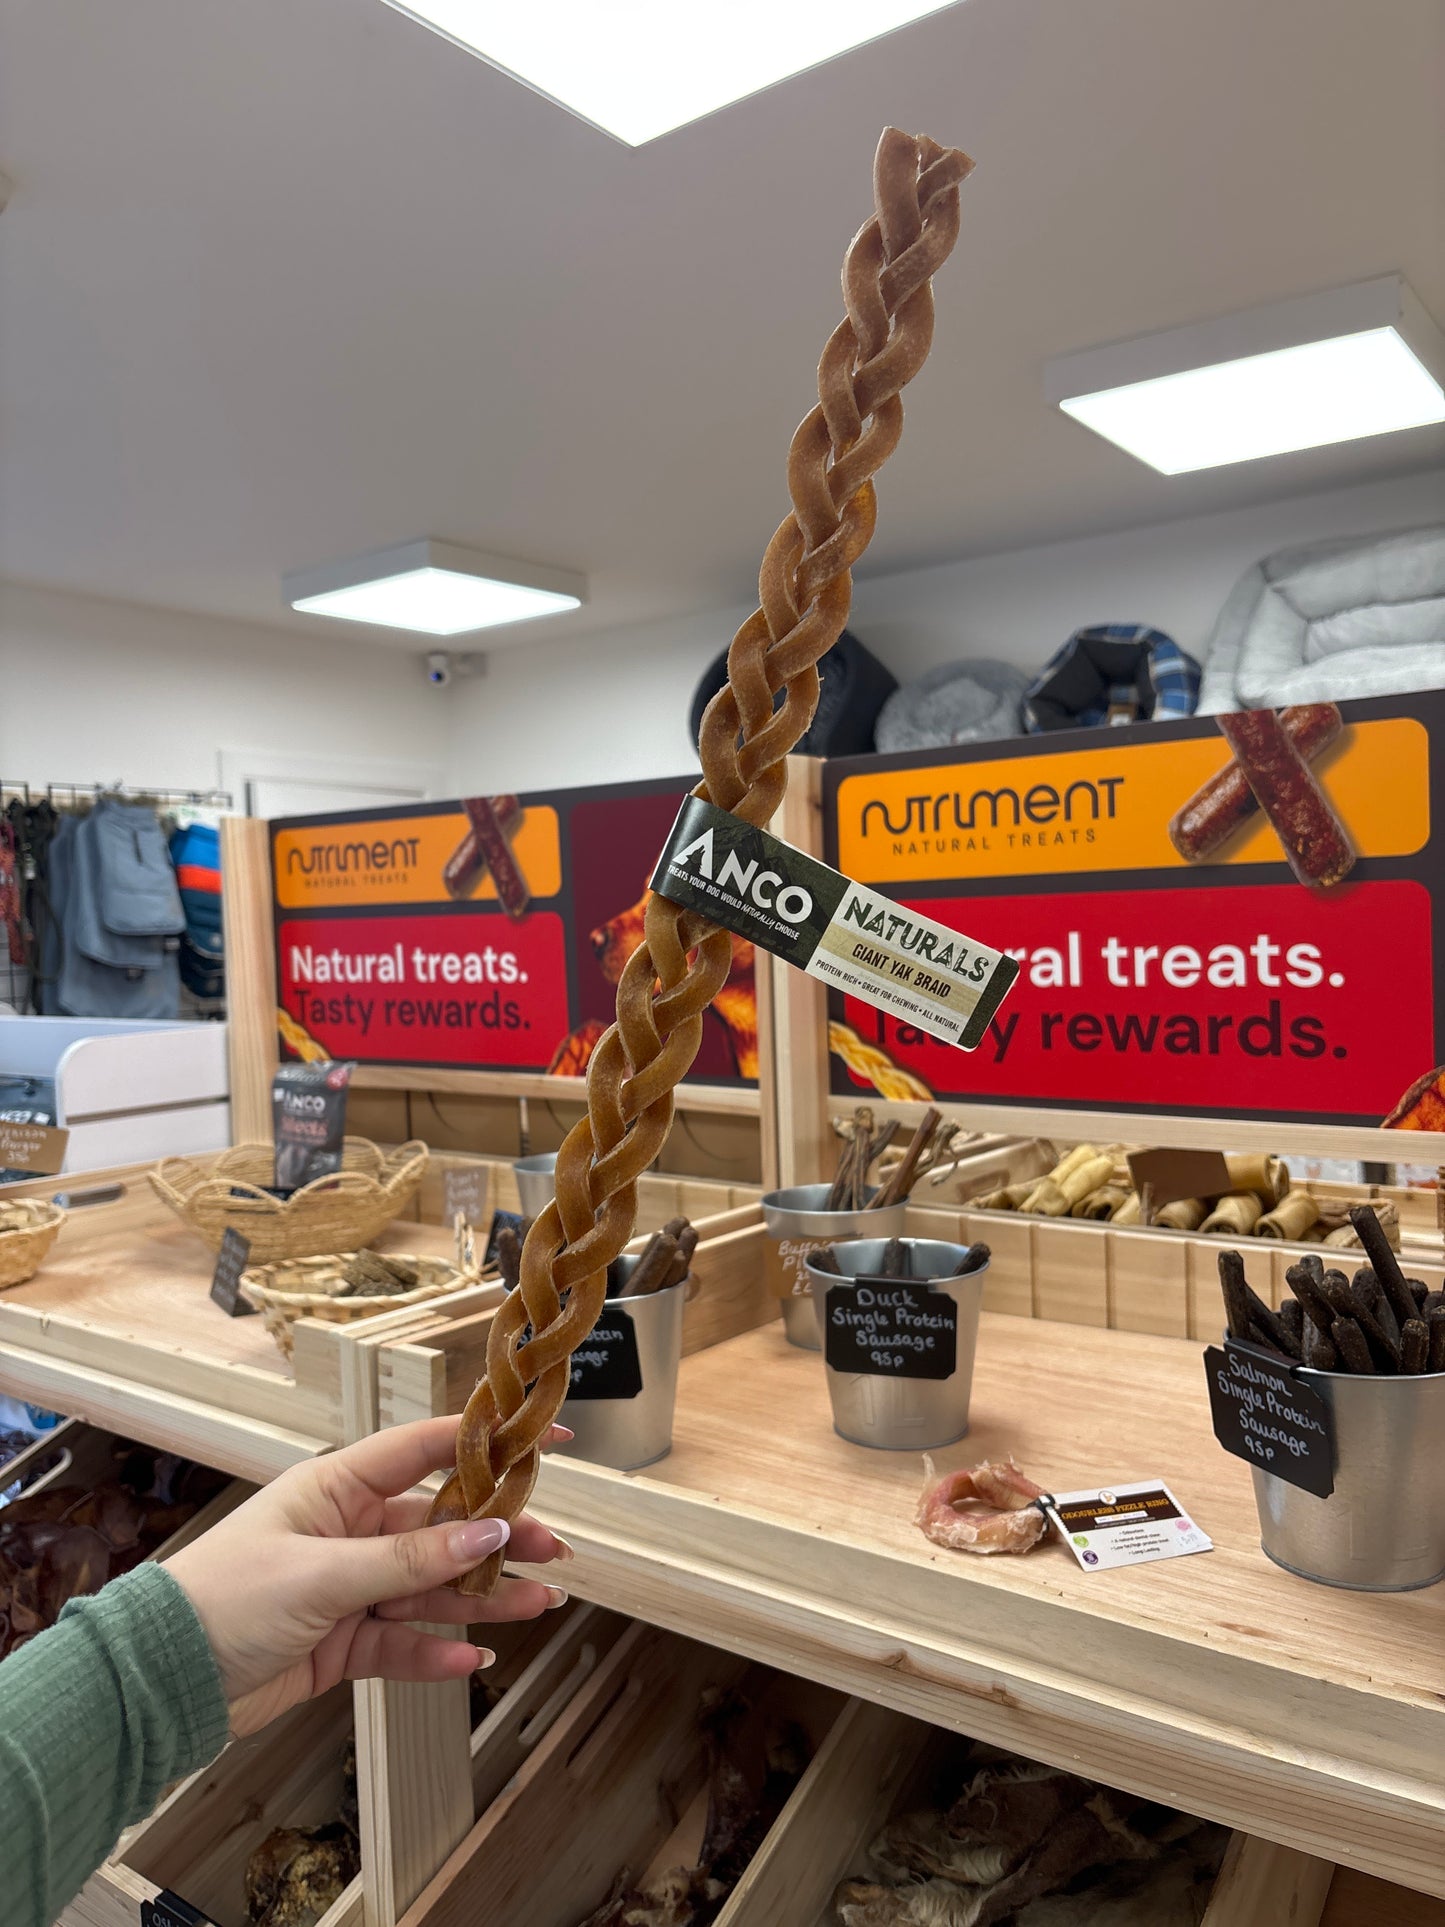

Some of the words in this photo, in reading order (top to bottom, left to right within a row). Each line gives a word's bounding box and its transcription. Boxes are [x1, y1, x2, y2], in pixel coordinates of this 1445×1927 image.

[892, 836, 991, 856] NATURAL
[1007, 828, 1097, 849] TREATS
[671, 827, 813, 924] ANCO
[667, 864, 689, 882] TREATS
[689, 874, 706, 892] YOUR
[706, 883, 721, 898] DOG
[720, 890, 743, 910] WOULD
[741, 903, 775, 930] NATURALLY
[774, 920, 801, 941] CHOOSE
[291, 942, 405, 983] Natural
[412, 946, 529, 984] treats.
[843, 896, 990, 983] NATURALS
[1101, 933, 1345, 988] treats.
[852, 943, 890, 970] GIANT
[890, 957, 914, 982] YAK
[913, 971, 951, 999] BRAID
[294, 989, 375, 1037] Tasty
[385, 990, 531, 1031] rewards.
[815, 959, 842, 978] PROTEIN
[842, 972, 858, 986] RICH
[861, 981, 881, 996] GREAT
[880, 989, 892, 1001] FOR
[891, 994, 918, 1013] CHEWING
[921, 1009, 934, 1020] ALL
[933, 1014, 960, 1032] NATURAL
[1040, 998, 1348, 1059] rewards.
[831, 1306, 889, 1333] Single
[895, 1307, 954, 1331] Protein
[856, 1288, 919, 1308] Duck
[855, 1329, 936, 1351] Sausage
[870, 1350, 904, 1368] 95p
[1228, 1352, 1293, 1398] Salmon
[1217, 1370, 1266, 1413] Single
[1266, 1391, 1326, 1436] Protein
[1239, 1408, 1310, 1457] Sausage
[1244, 1435, 1275, 1461] 95p
[1115, 1501, 1146, 1513] PIZZLE
